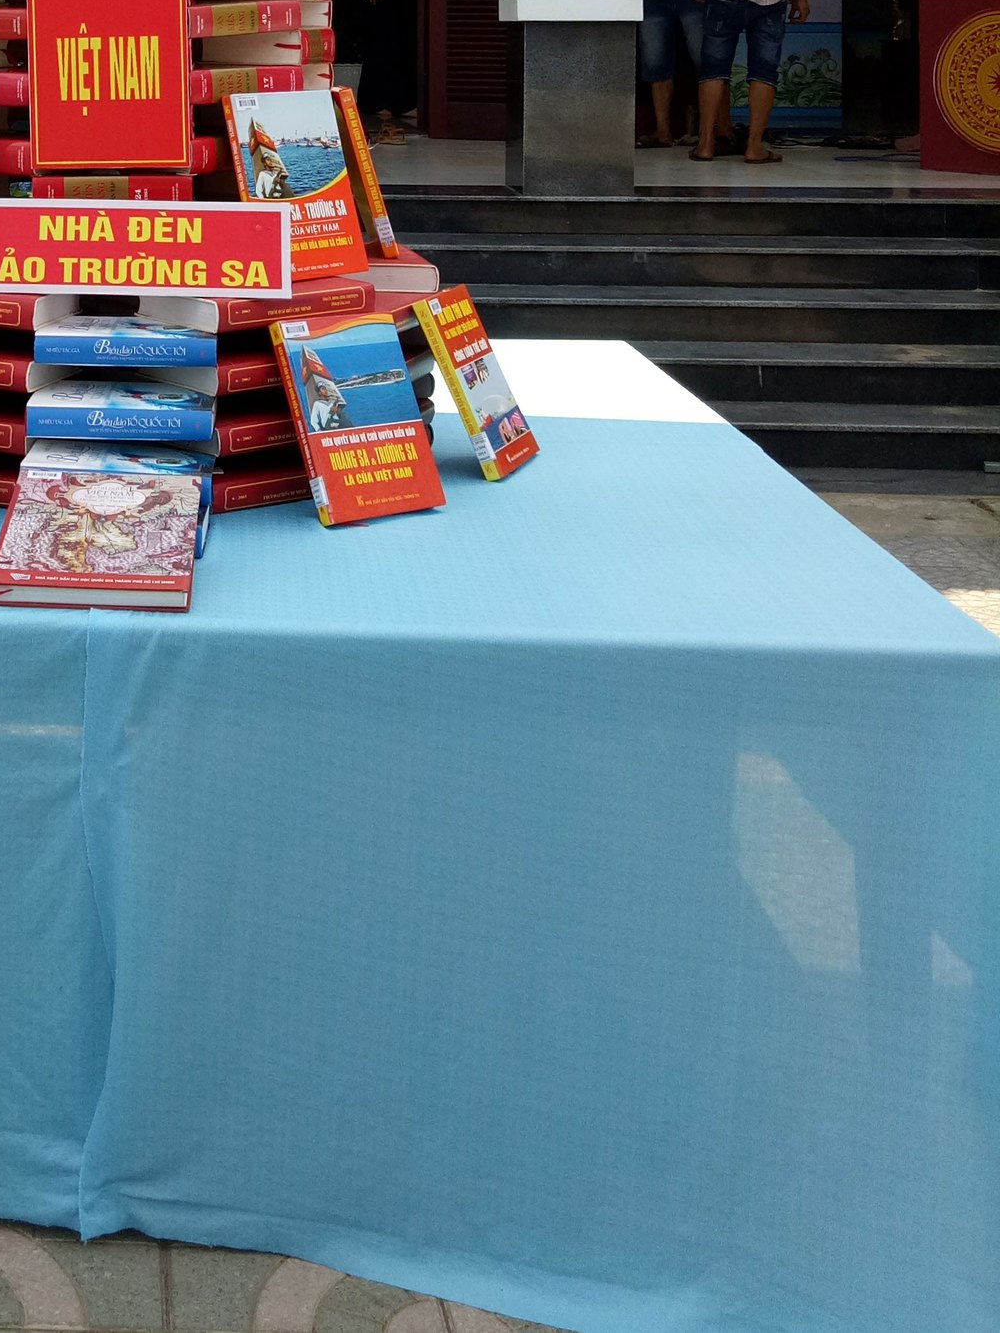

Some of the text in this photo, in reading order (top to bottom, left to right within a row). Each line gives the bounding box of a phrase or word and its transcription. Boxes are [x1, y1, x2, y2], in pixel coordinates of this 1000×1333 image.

[261, 13, 268, 25] 49
[56, 22, 161, 117] VIỆT NAM
[263, 77, 270, 88] 17
[134, 188, 142, 200] 24
[290, 204, 302, 221] SA
[304, 199, 336, 219] TRƯỜNG
[335, 199, 348, 216] SA
[38, 210, 202, 244] NHÀ ĐÈN
[290, 223, 340, 236] CỦA VIỆT NAM
[58, 251, 208, 287] TRƯỜNG
[221, 259, 270, 288] SA
[329, 442, 418, 471] HOÀNG SA & TRƯỜNG SA
[344, 466, 413, 486] LÀ CỦA VIỆT NAM
